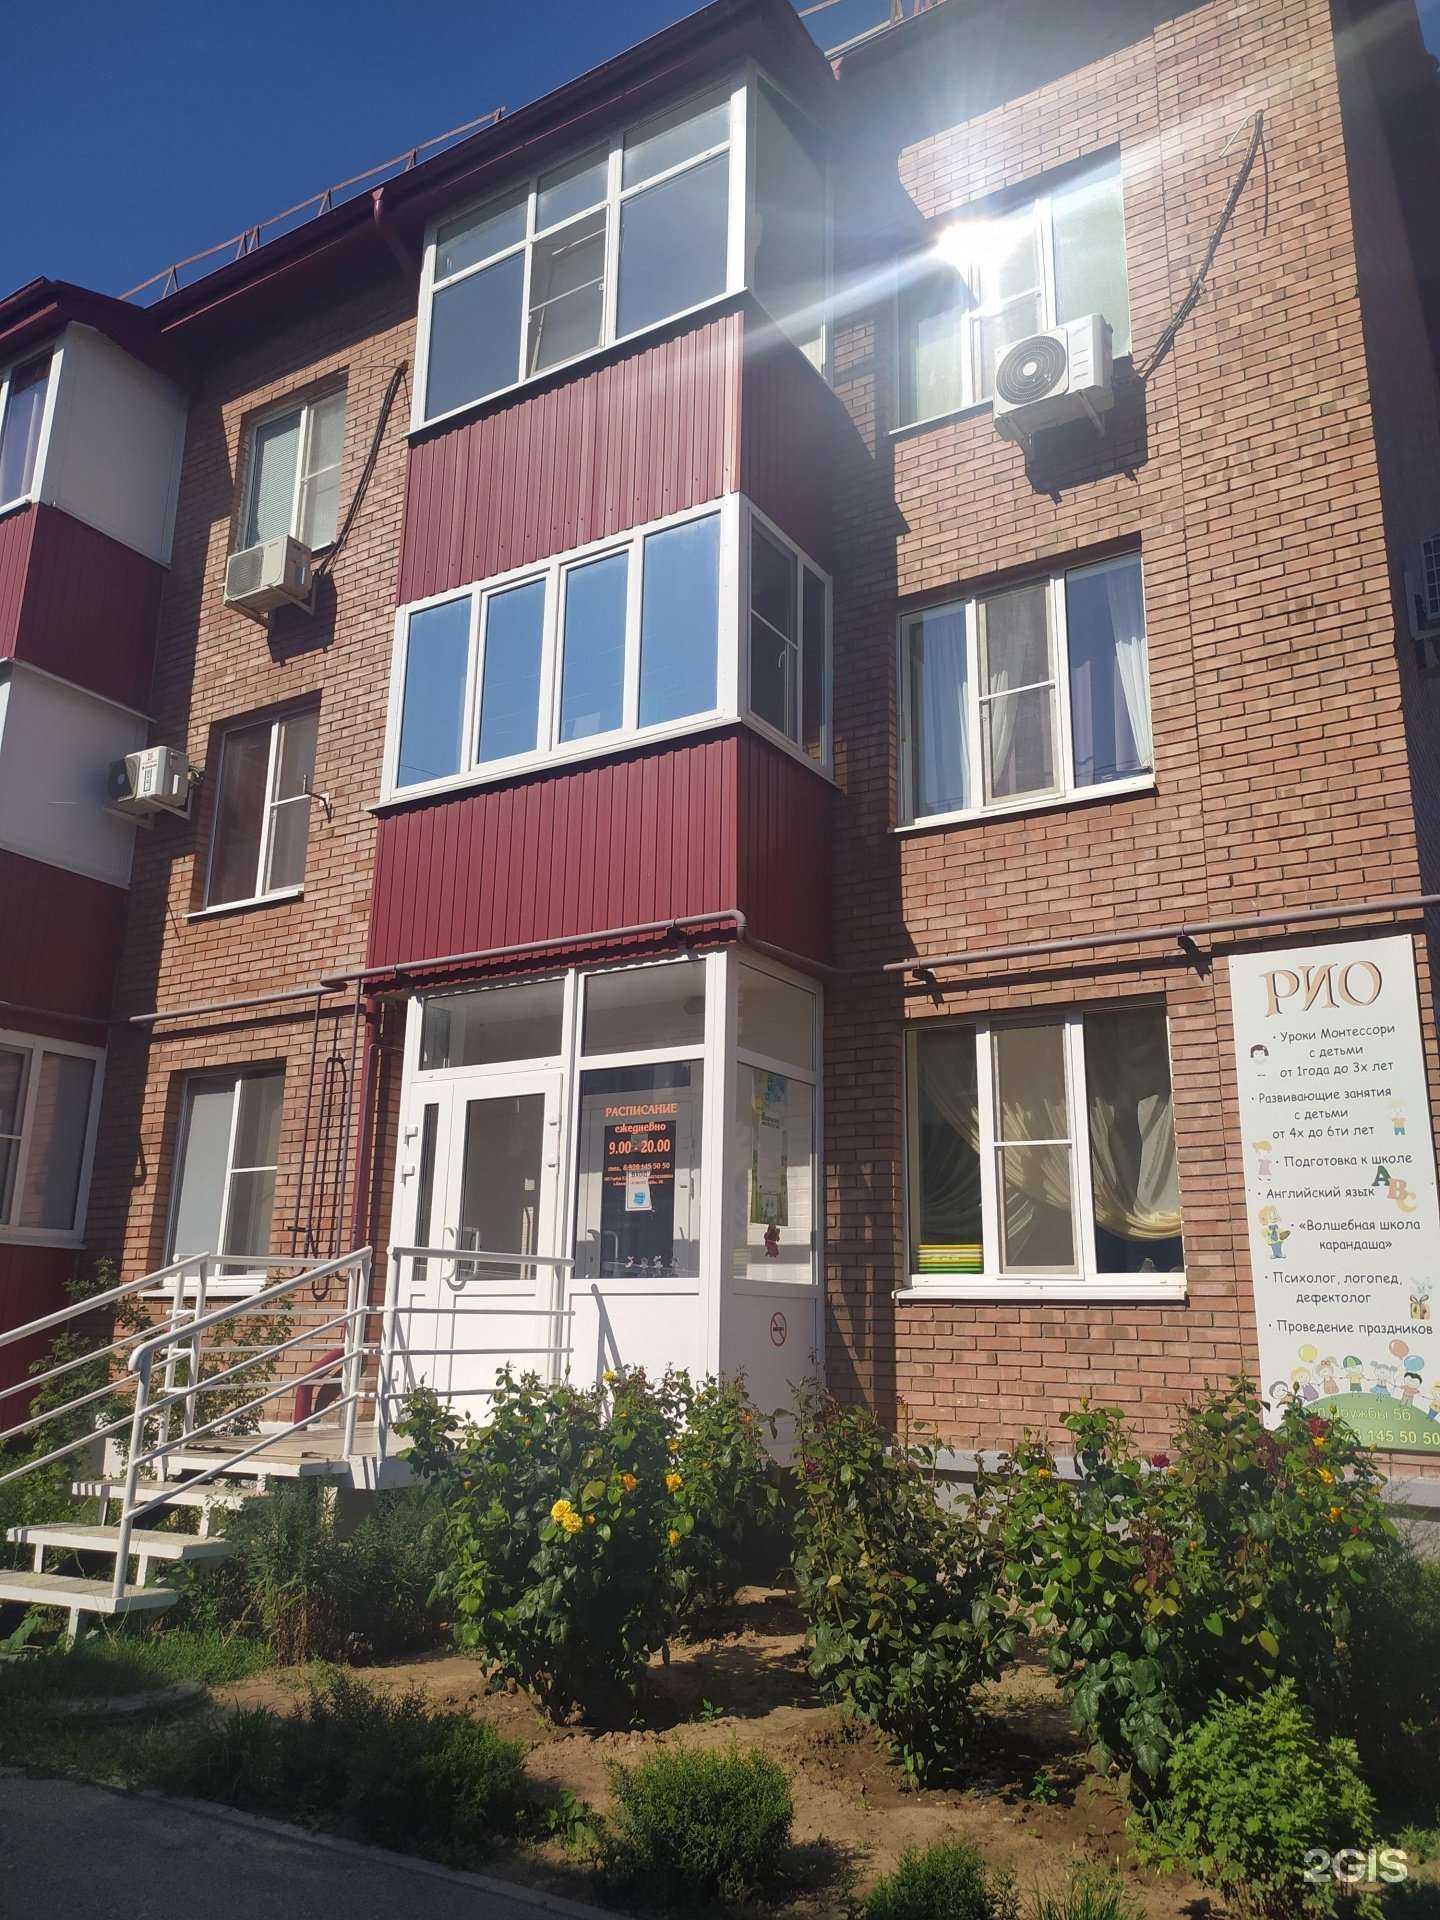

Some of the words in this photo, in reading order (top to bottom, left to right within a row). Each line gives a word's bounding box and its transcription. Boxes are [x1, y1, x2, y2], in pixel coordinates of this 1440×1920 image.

[1258, 960, 1383, 1018] РИО
[1279, 1031, 1316, 1045] Уроки
[1320, 1025, 1395, 1041] Монтессори
[1309, 1048, 1316, 1058] с
[1319, 1046, 1363, 1059] детьми
[1279, 1068, 1293, 1078] от
[1297, 1064, 1330, 1078] 1года
[1334, 1064, 1349, 1075] до
[1353, 1062, 1368, 1073] 3х
[1371, 1060, 1394, 1073] лет
[1258, 1090, 1340, 1105] Развивающие
[1344, 1088, 1392, 1100] занятия
[605, 1103, 678, 1118] РАСПИСАНИЕ
[1294, 1110, 1301, 1120] с
[1304, 1108, 1348, 1121] детьми
[614, 1121, 666, 1135] ежедневно
[1272, 1129, 1286, 1140] от
[1289, 1127, 1304, 1138] 4х
[1308, 1127, 1323, 1138] до
[1327, 1125, 1349, 1137] 6ти
[1353, 1125, 1375, 1136] лет
[608, 1140, 631, 1155] 9.00
[640, 1138, 671, 1154] 20.00
[1284, 1155, 1357, 1169] Подготовка
[1361, 1156, 1368, 1165] к
[1371, 1153, 1413, 1166] школе
[1266, 1187, 1341, 1200] Английский
[1345, 1187, 1375, 1198] язык
[1299, 1219, 1376, 1232] «Волшебная
[1379, 1220, 1421, 1231] школа
[1319, 1239, 1392, 1252] карандаша»
[1273, 1271, 1340, 1286] Психолог,
[1344, 1273, 1403, 1286] логопед,
[1296, 1291, 1371, 1306] дефектолог
[1277, 1320, 1354, 1334] Проведение
[1358, 1323, 1433, 1336] праздников
[1368, 1430, 1394, 1442] 145
[1400, 1431, 1417, 1443] 50
[1423, 1432, 1440, 1445] 50
